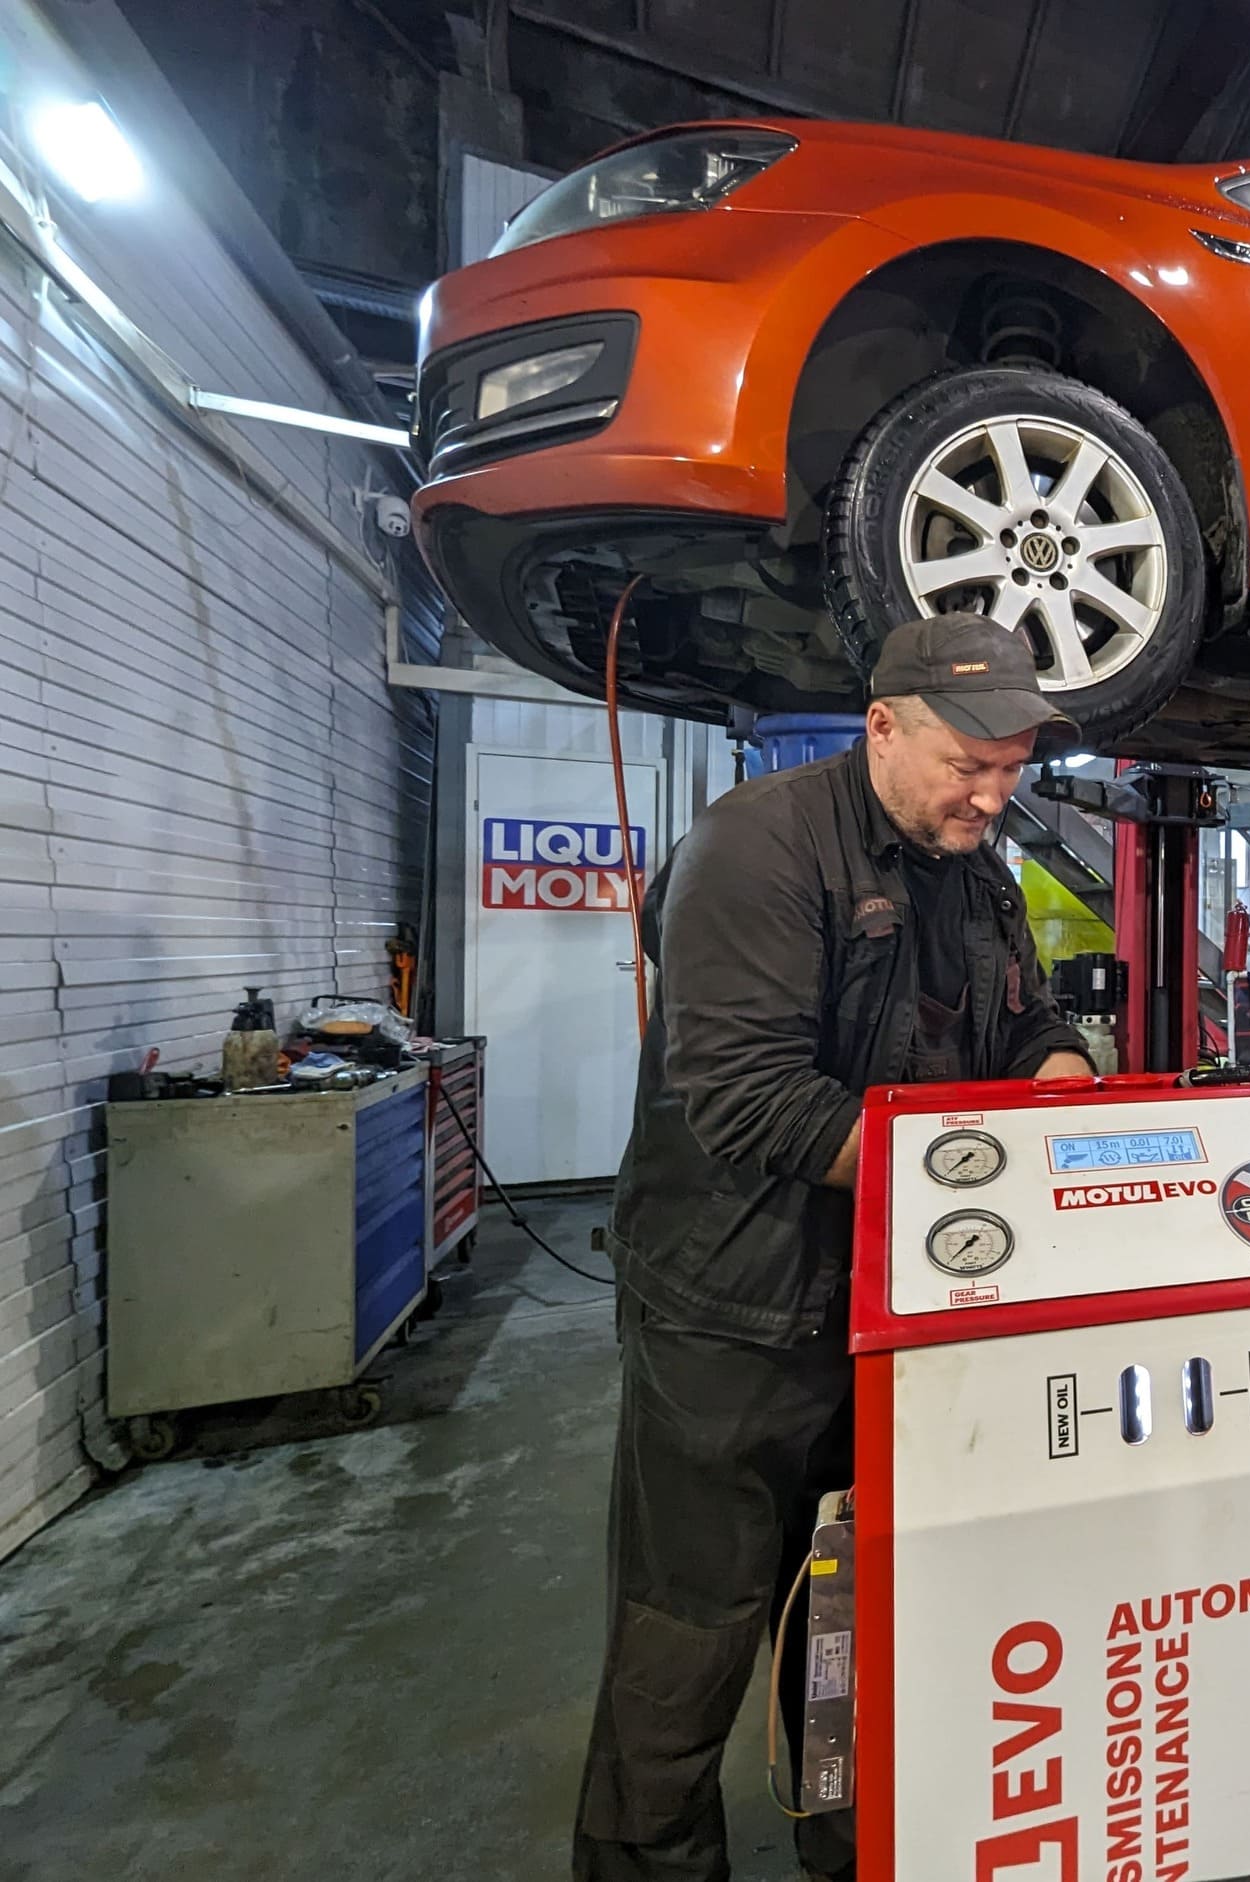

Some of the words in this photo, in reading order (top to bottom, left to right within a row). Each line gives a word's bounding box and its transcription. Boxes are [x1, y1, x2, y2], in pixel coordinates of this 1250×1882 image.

[492, 822, 638, 866] LIQUI
[490, 868, 642, 908] MOLY
[1060, 1143, 1076, 1152] ON
[1060, 1184, 1157, 1207] MOTUL
[1163, 1180, 1217, 1198] EVO
[954, 1294, 995, 1303] PRESSURE
[1056, 1384, 1069, 1410] OIL
[1058, 1413, 1070, 1448] NEW
[991, 1620, 1064, 1821] EVO
